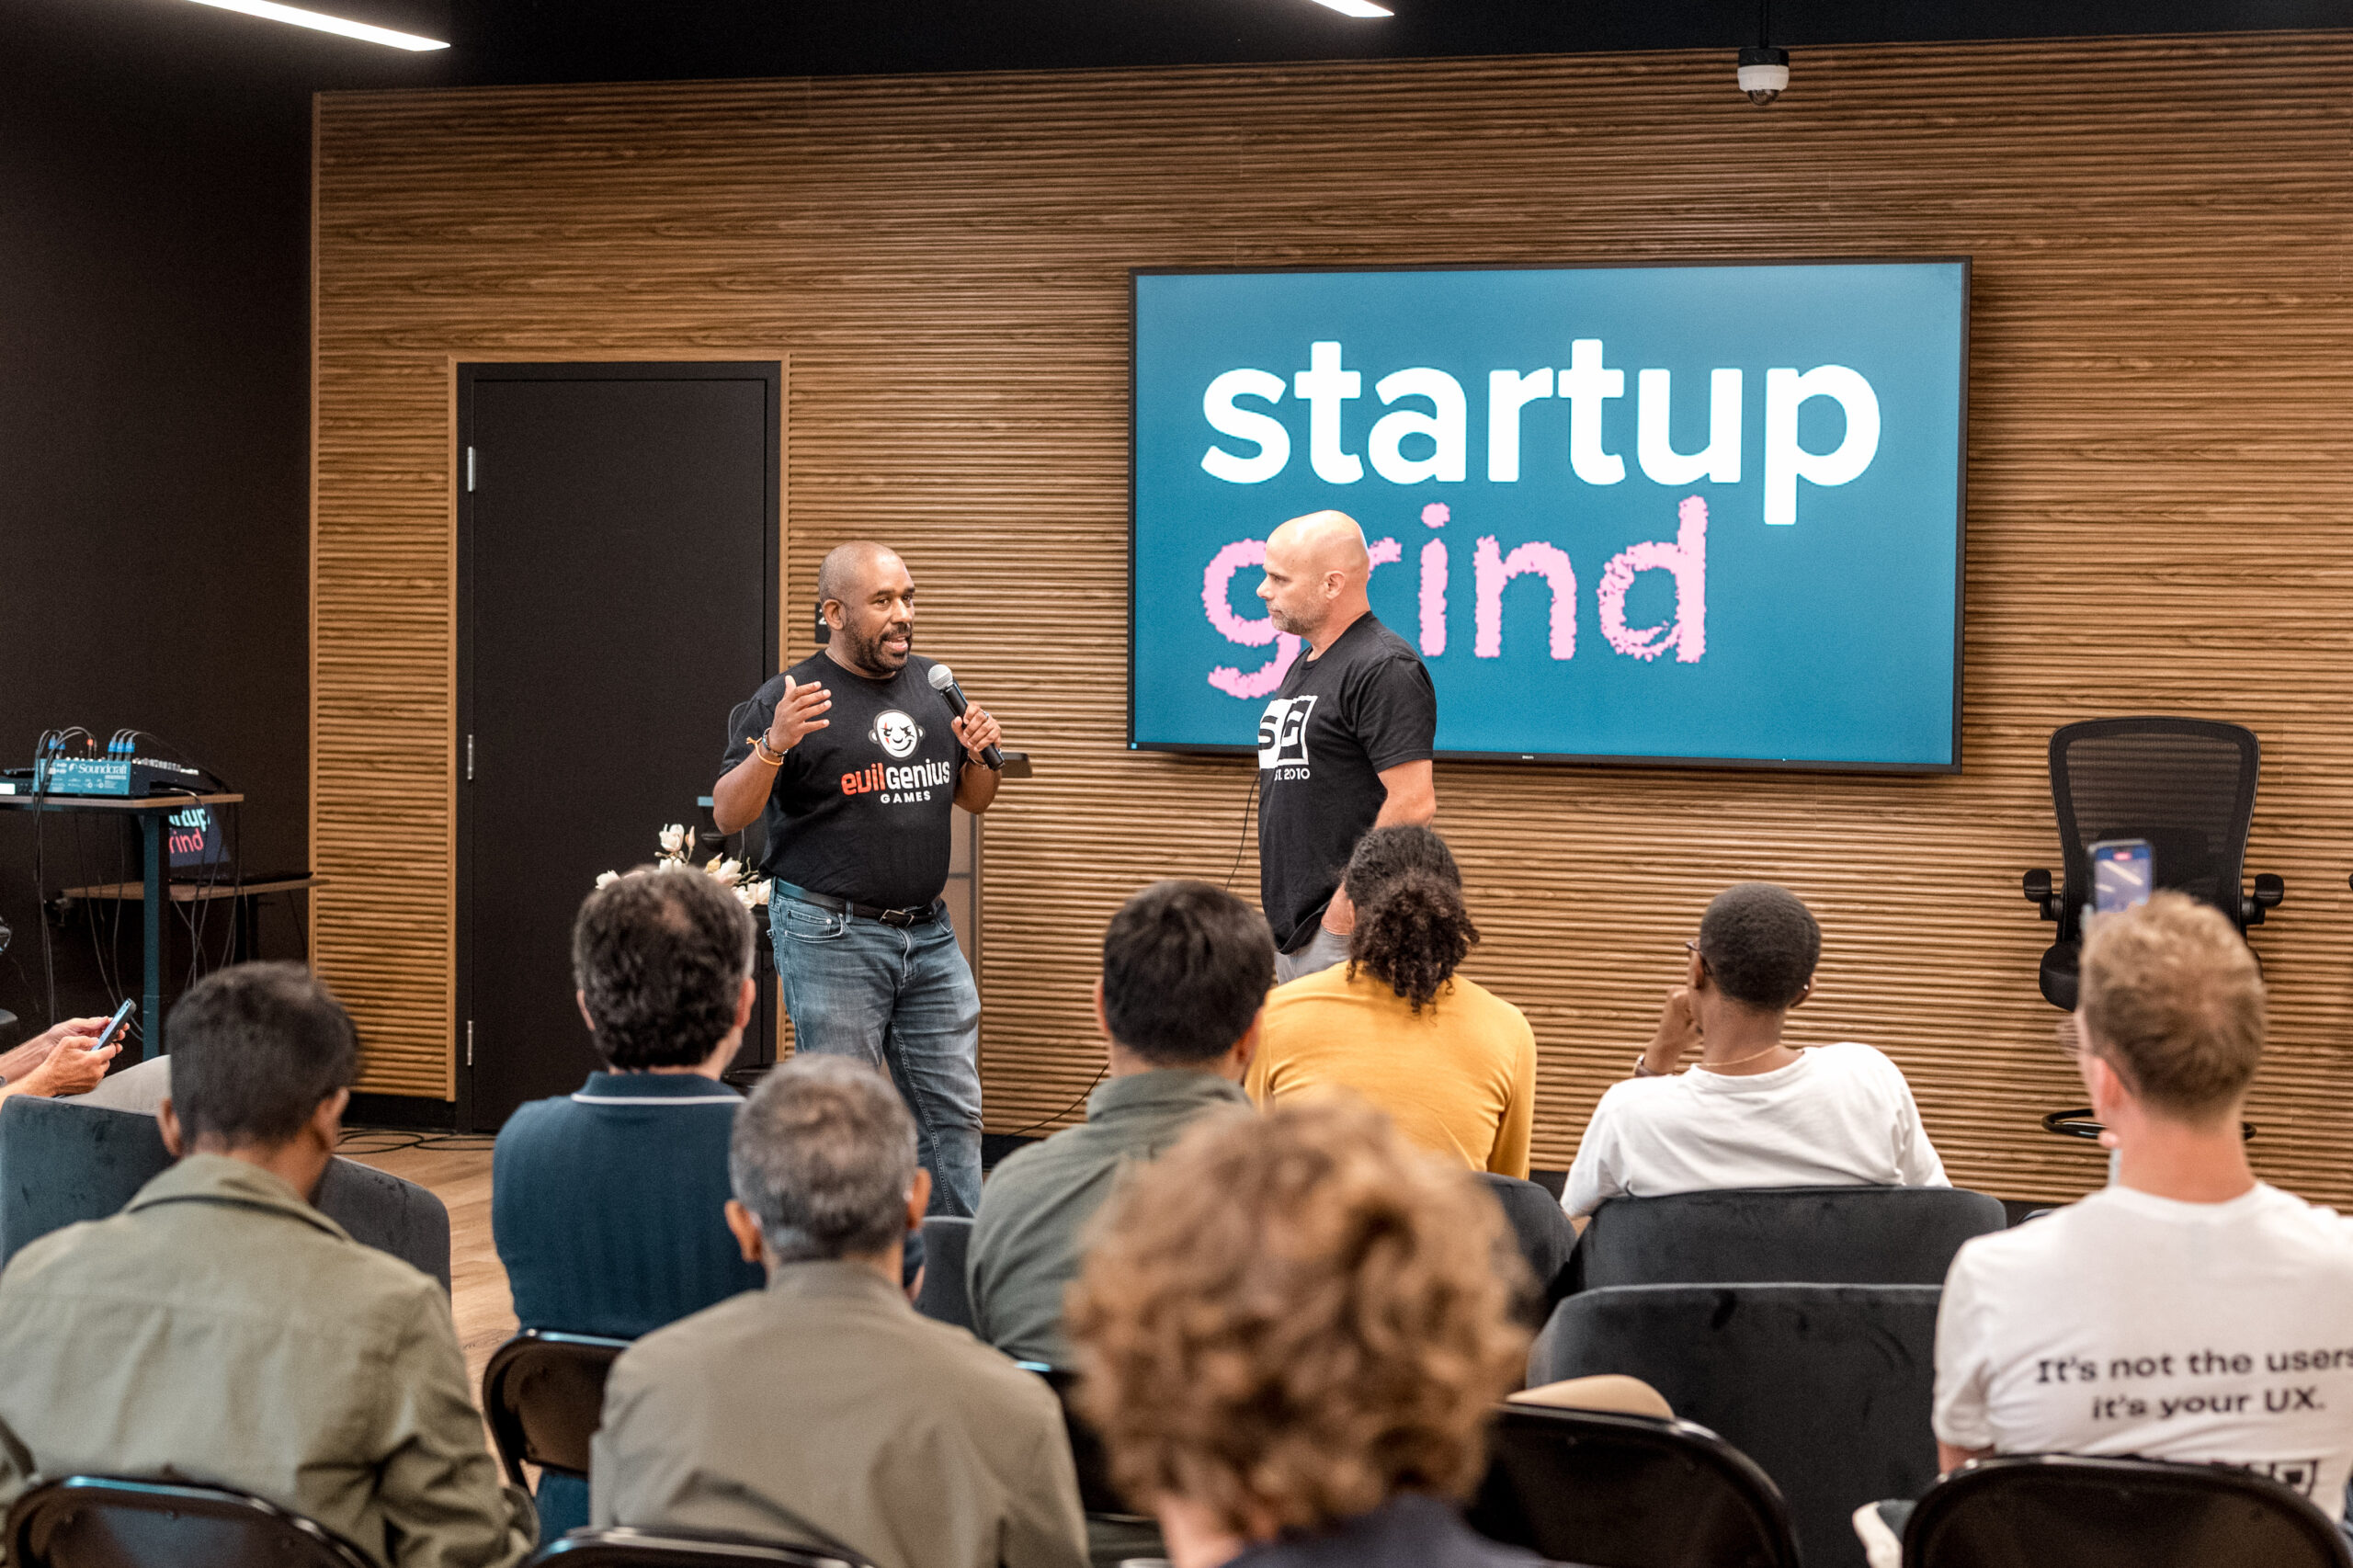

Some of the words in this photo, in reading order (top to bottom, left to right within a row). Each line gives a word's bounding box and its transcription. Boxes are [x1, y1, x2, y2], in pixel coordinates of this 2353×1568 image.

[1200, 339, 1881, 526] startup
[78, 763, 127, 775] Soundcraft
[1283, 767, 1311, 780] 2010
[880, 790, 931, 804] GAMES
[168, 827, 204, 854] rind
[2038, 1356, 2098, 1382] It's
[2110, 1354, 2174, 1380] not
[2188, 1348, 2253, 1375] the
[2091, 1394, 2148, 1421] it's
[2159, 1393, 2251, 1421] your
[2264, 1385, 2325, 1413] UX.
